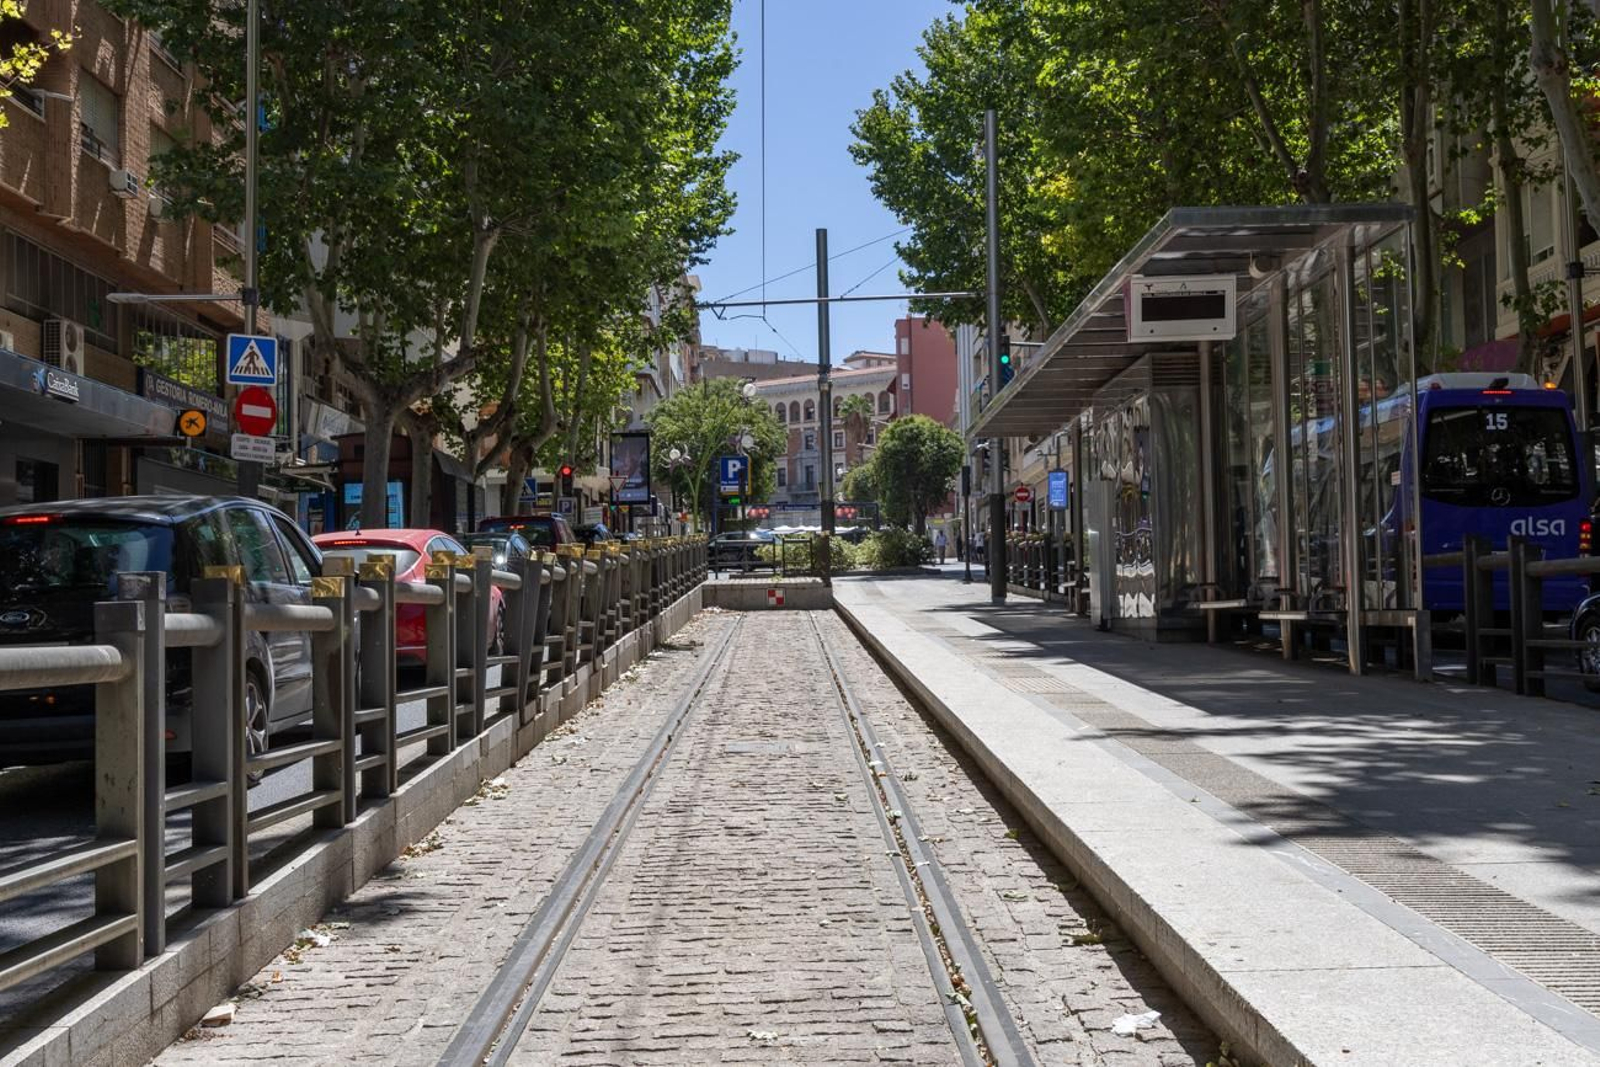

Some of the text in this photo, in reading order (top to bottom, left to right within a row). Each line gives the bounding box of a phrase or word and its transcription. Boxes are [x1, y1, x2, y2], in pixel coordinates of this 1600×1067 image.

[47, 372, 79, 396] CaixaBank
[155, 378, 187, 403] GESTORIA
[1485, 413, 1508, 430] 15
[727, 459, 742, 479] P
[1510, 516, 1566, 537] alsa
